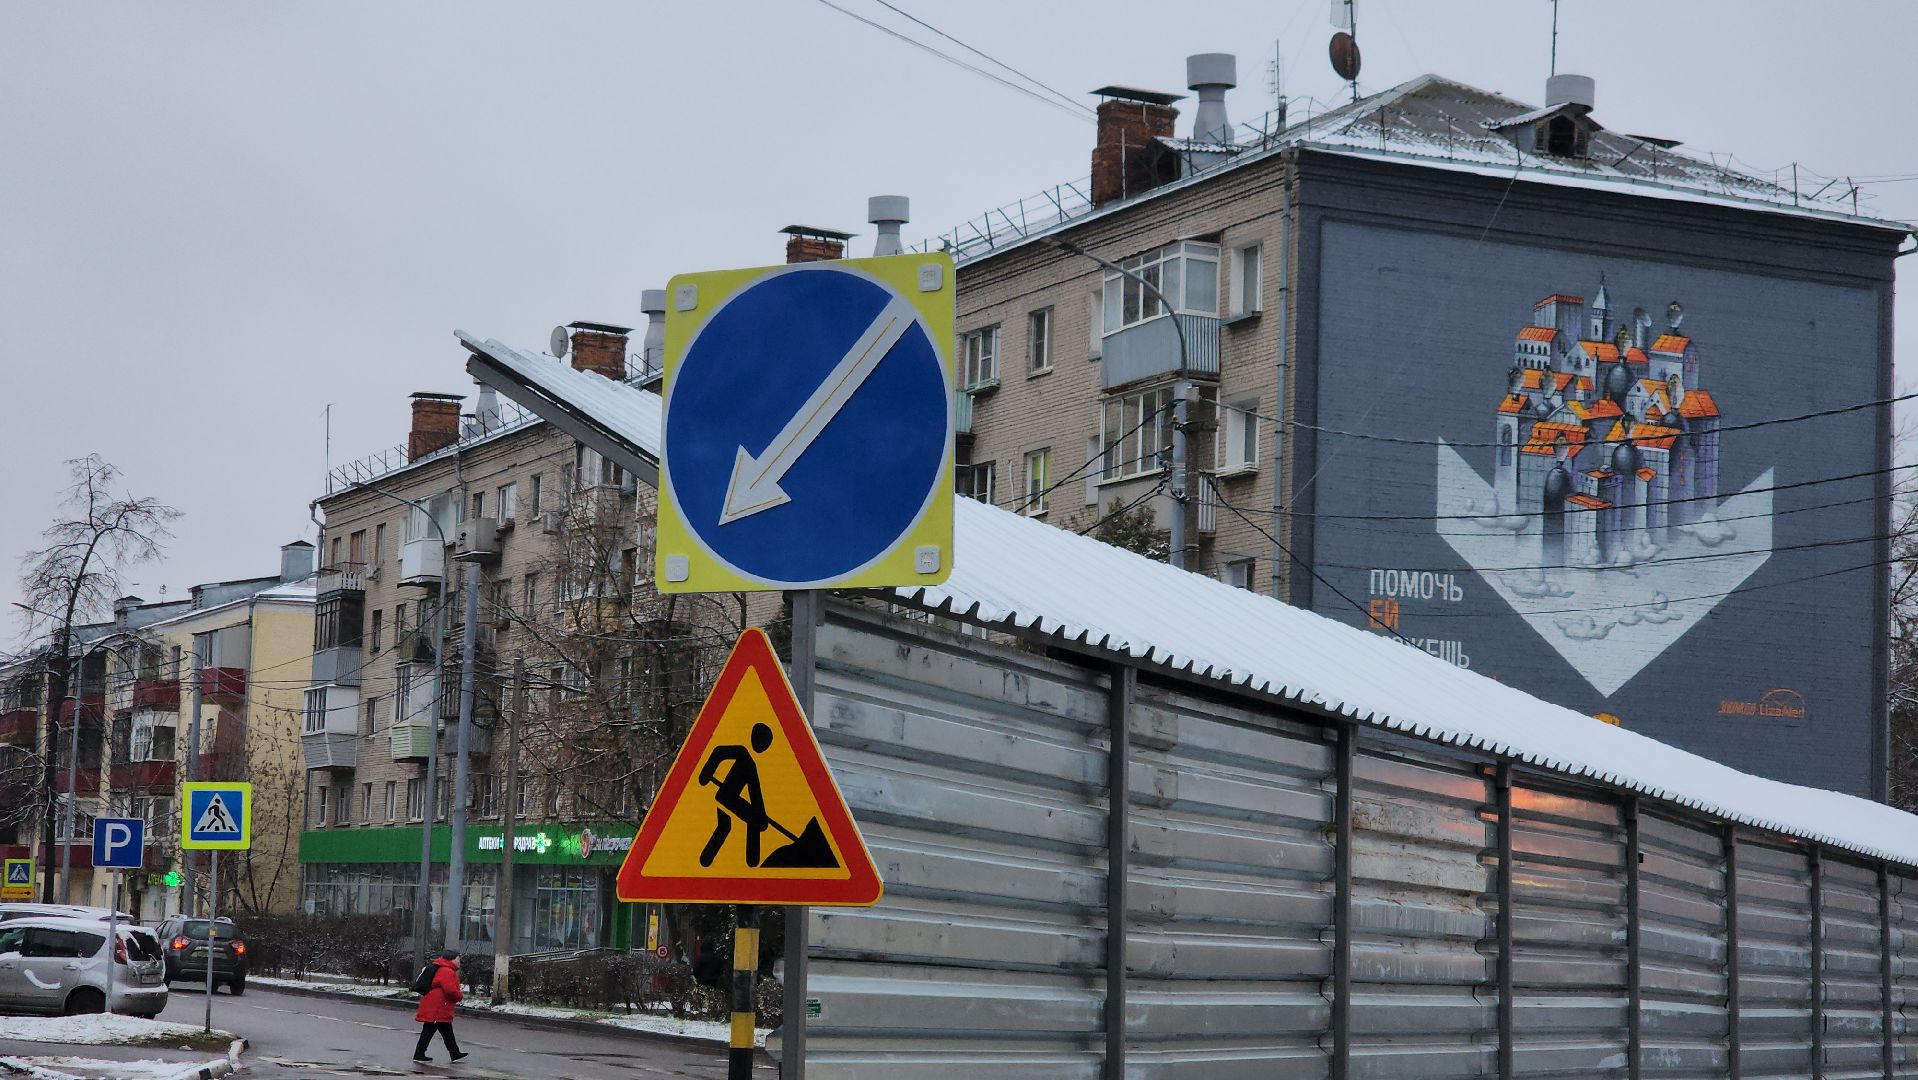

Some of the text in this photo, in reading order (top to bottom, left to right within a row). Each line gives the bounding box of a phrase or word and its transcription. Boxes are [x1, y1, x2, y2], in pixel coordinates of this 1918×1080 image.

[1370, 569, 1464, 602] ПОМОЧЬ
[1369, 598, 1400, 630] ЕЙ
[104, 823, 131, 861] P
[478, 836, 500, 850] АПТЕКИ
